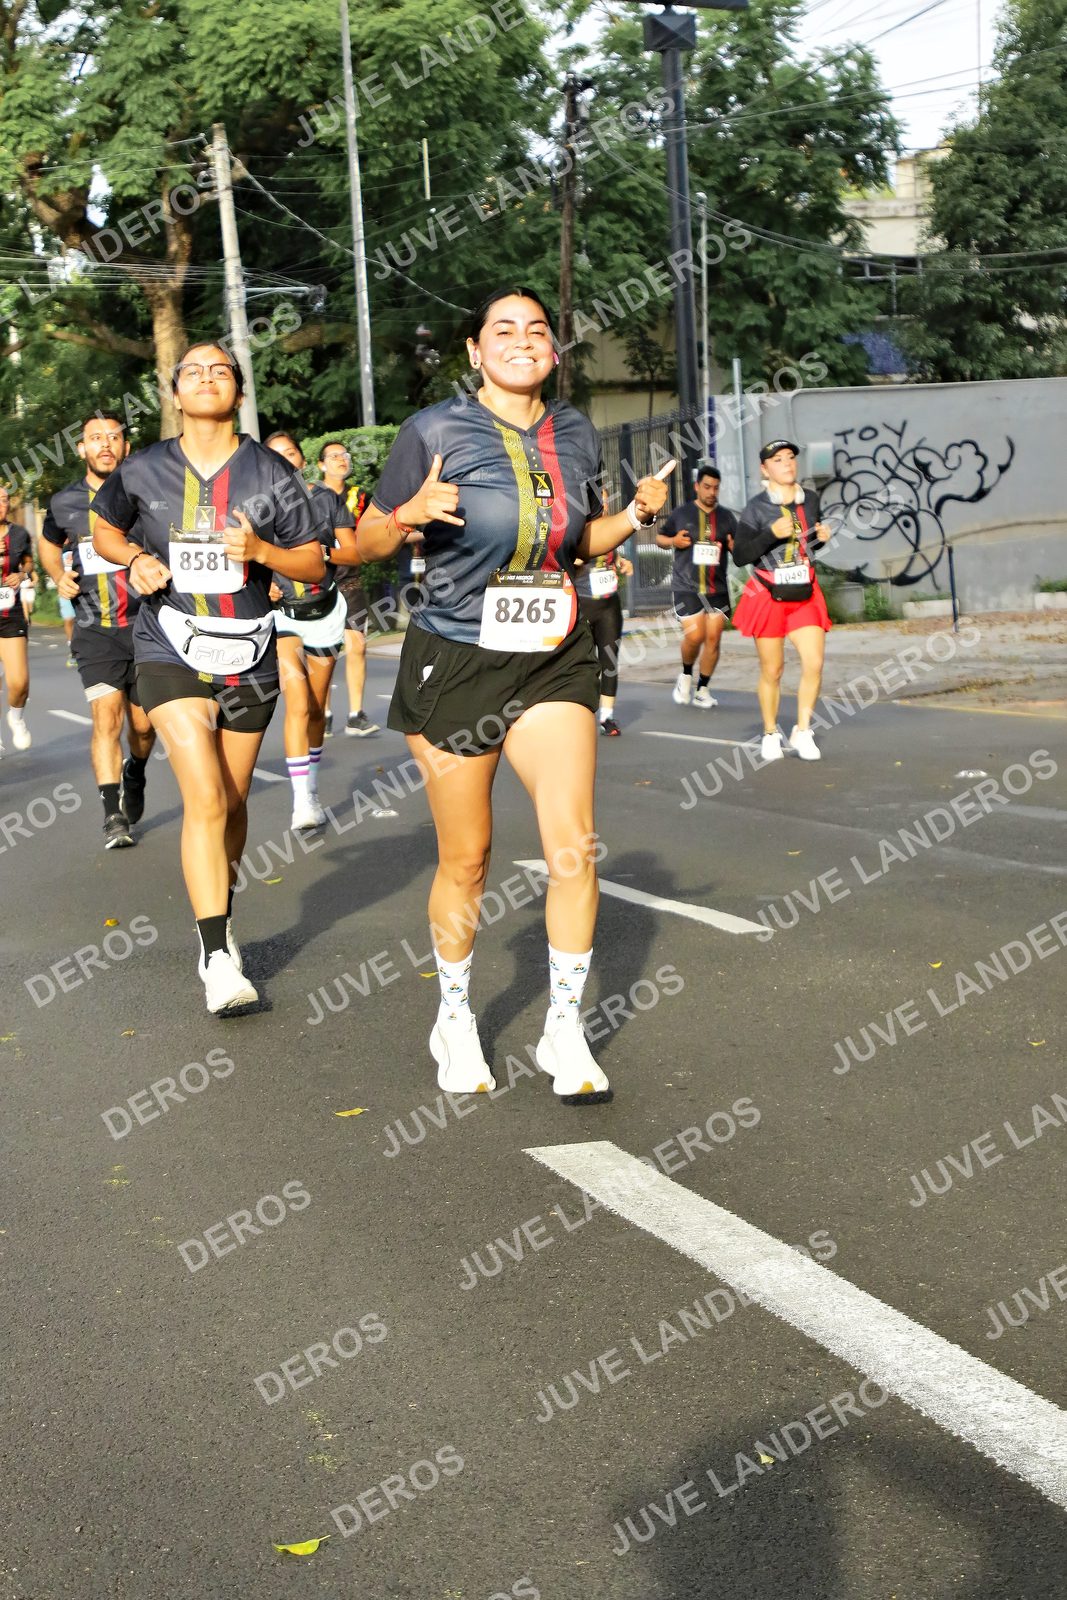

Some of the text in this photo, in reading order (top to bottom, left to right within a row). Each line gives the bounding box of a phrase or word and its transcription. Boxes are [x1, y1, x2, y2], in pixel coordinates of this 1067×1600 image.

[834, 419, 907, 449] TOY
[179, 551, 230, 572] 8581
[495, 597, 557, 624] 8265
[194, 646, 246, 666] FILA
